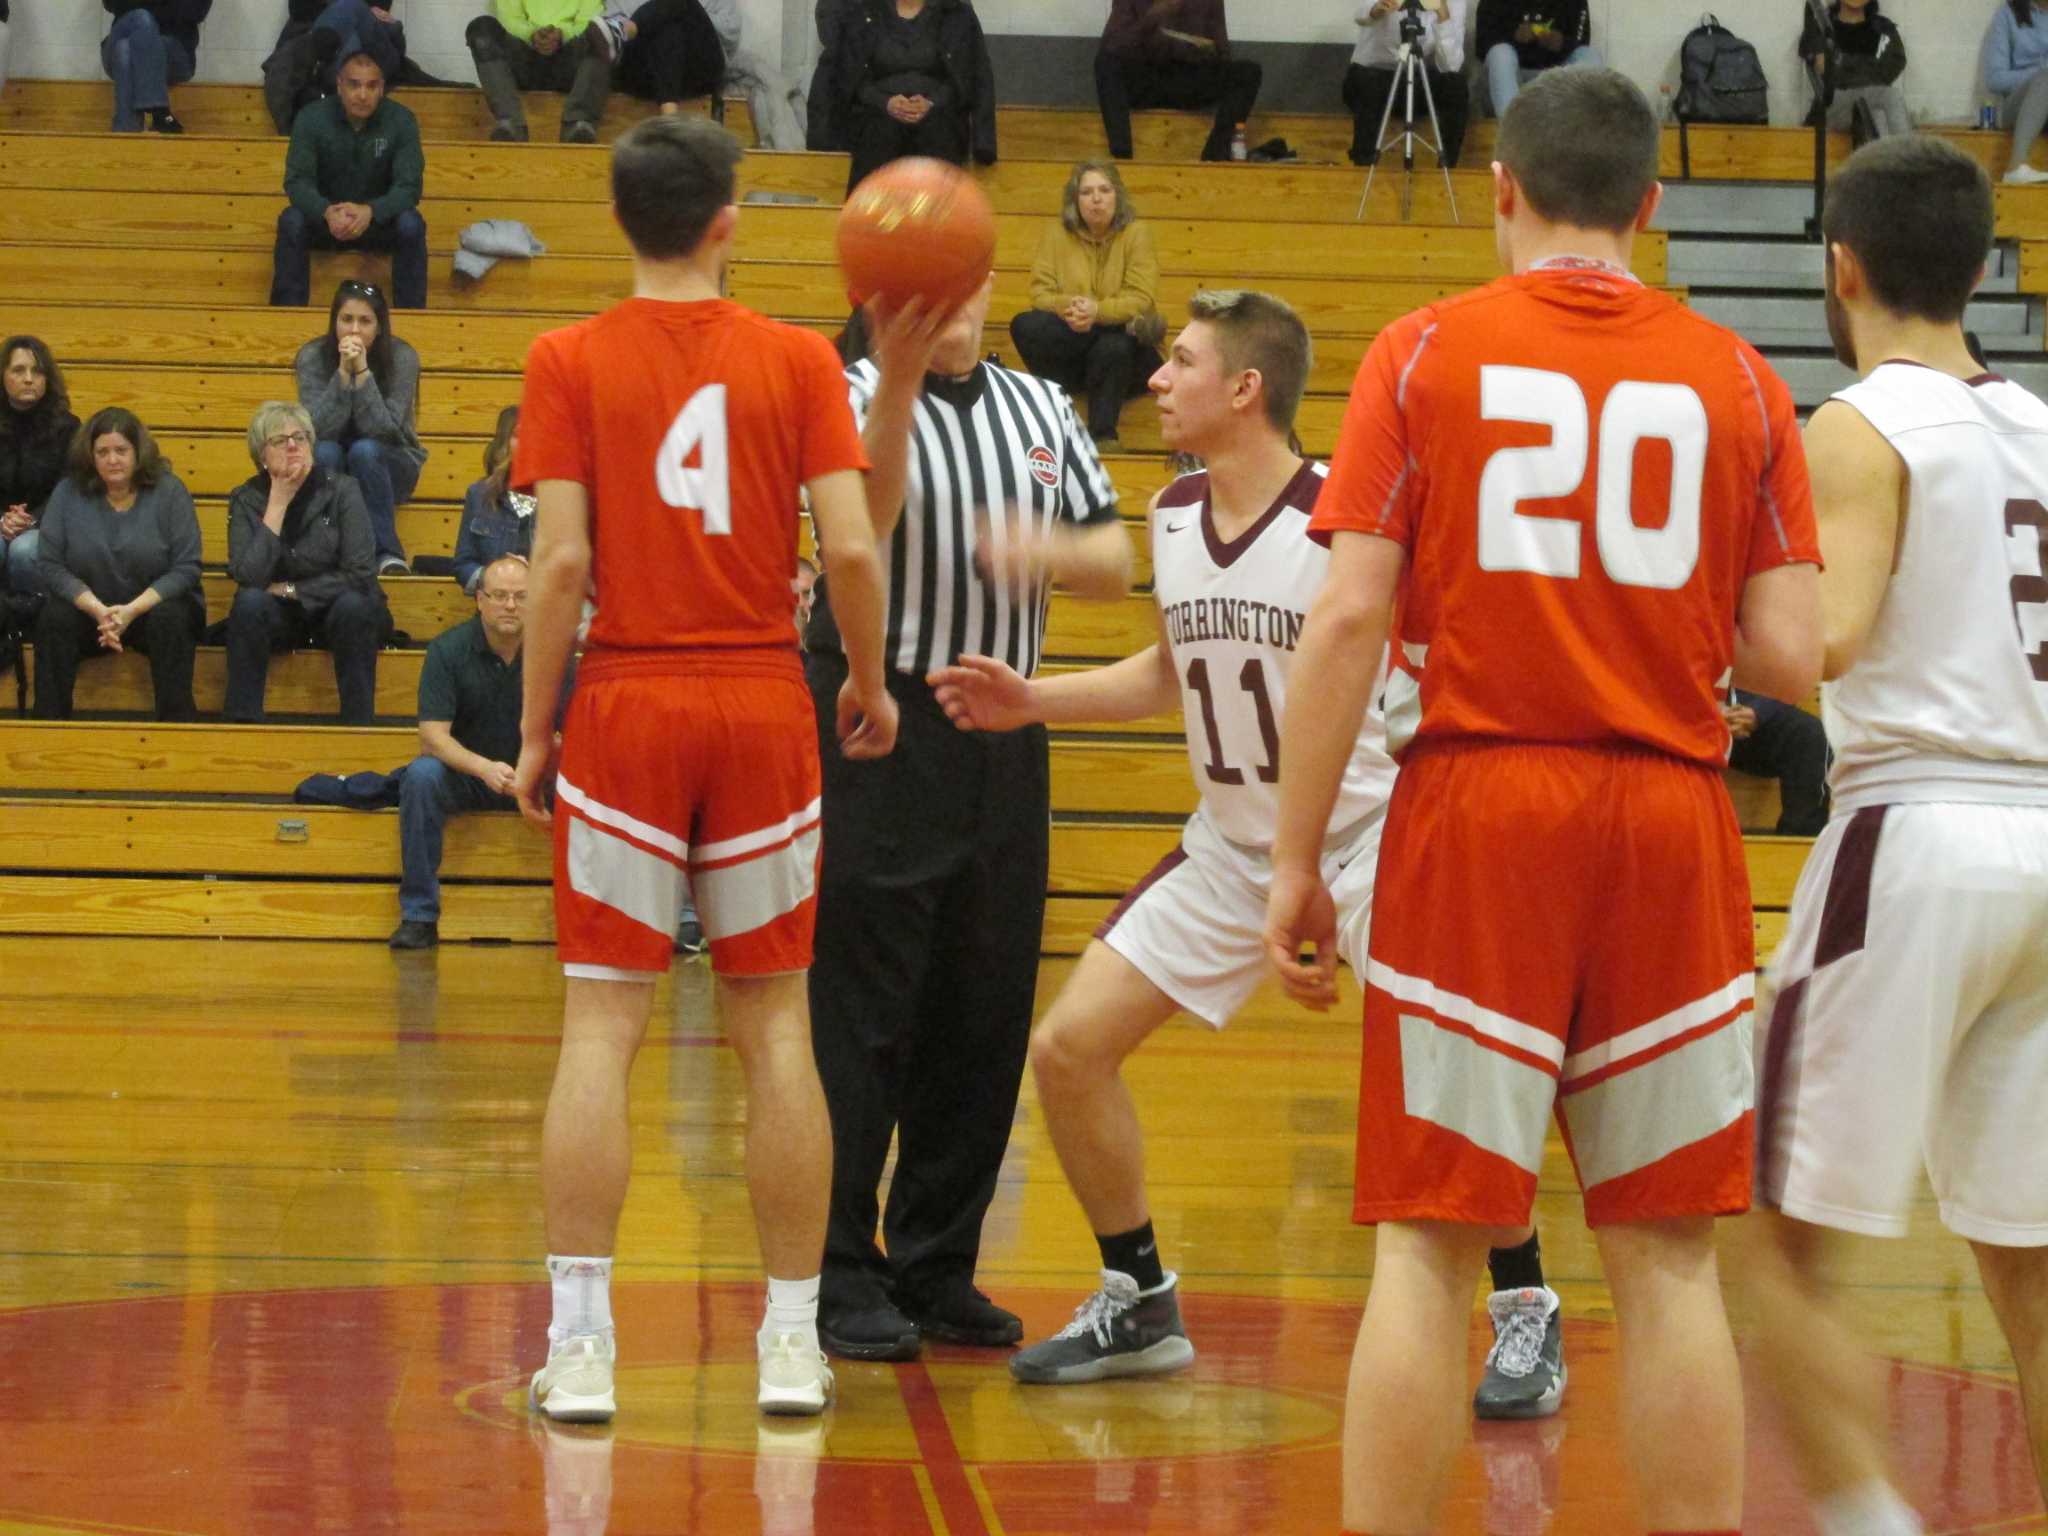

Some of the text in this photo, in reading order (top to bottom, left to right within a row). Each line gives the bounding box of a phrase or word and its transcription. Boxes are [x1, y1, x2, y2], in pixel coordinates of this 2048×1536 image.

[656, 382, 732, 535] 4
[1478, 364, 1709, 590] 20
[1187, 658, 1280, 785] 11
